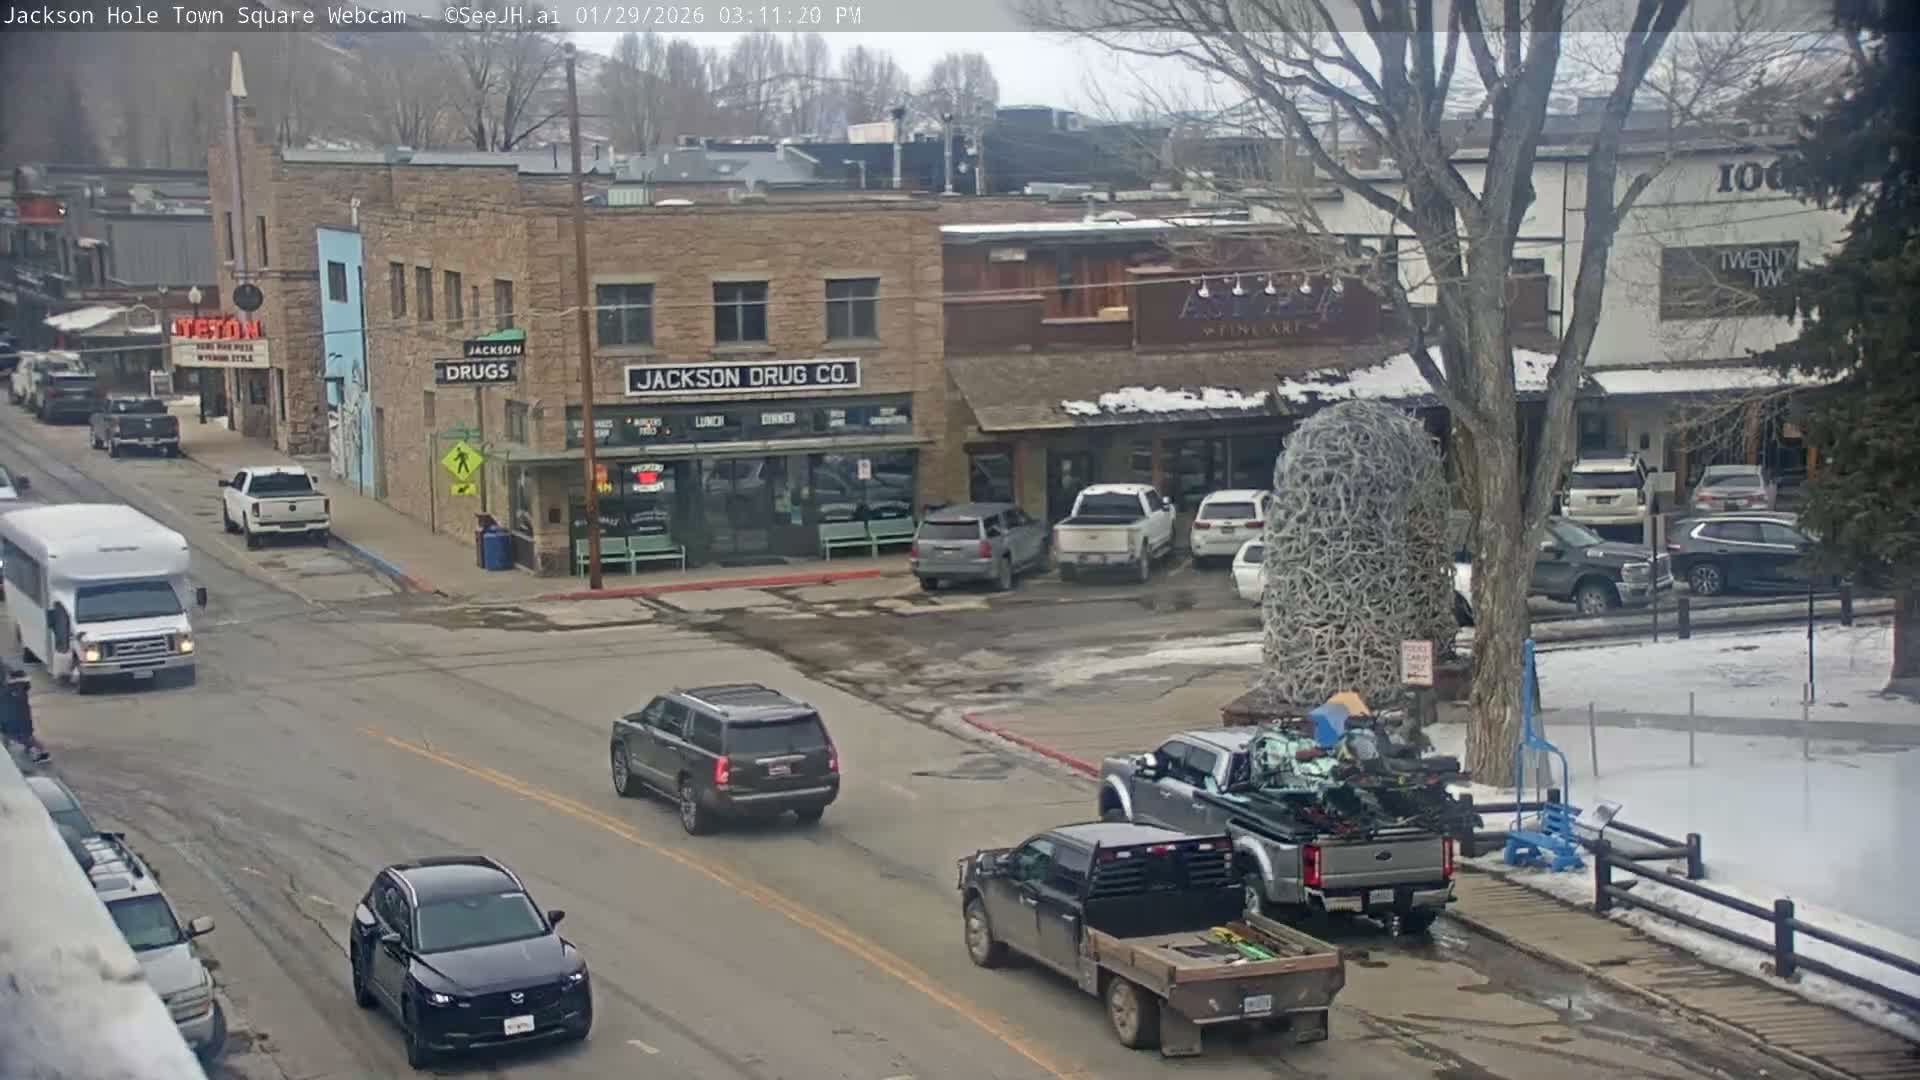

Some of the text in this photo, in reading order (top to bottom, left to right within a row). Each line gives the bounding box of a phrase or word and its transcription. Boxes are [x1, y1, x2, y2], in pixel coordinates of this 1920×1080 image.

[1720, 248, 1798, 270] TWENTY
[1752, 268, 1788, 288] TW
[176, 318, 261, 339] TETON
[469, 345, 521, 355] JACKSON
[446, 363, 510, 380] DRUGS
[637, 364, 848, 389] JACKSON DRUG CO.
[695, 415, 724, 428] LUNCH
[761, 412, 796, 425] DINNER
